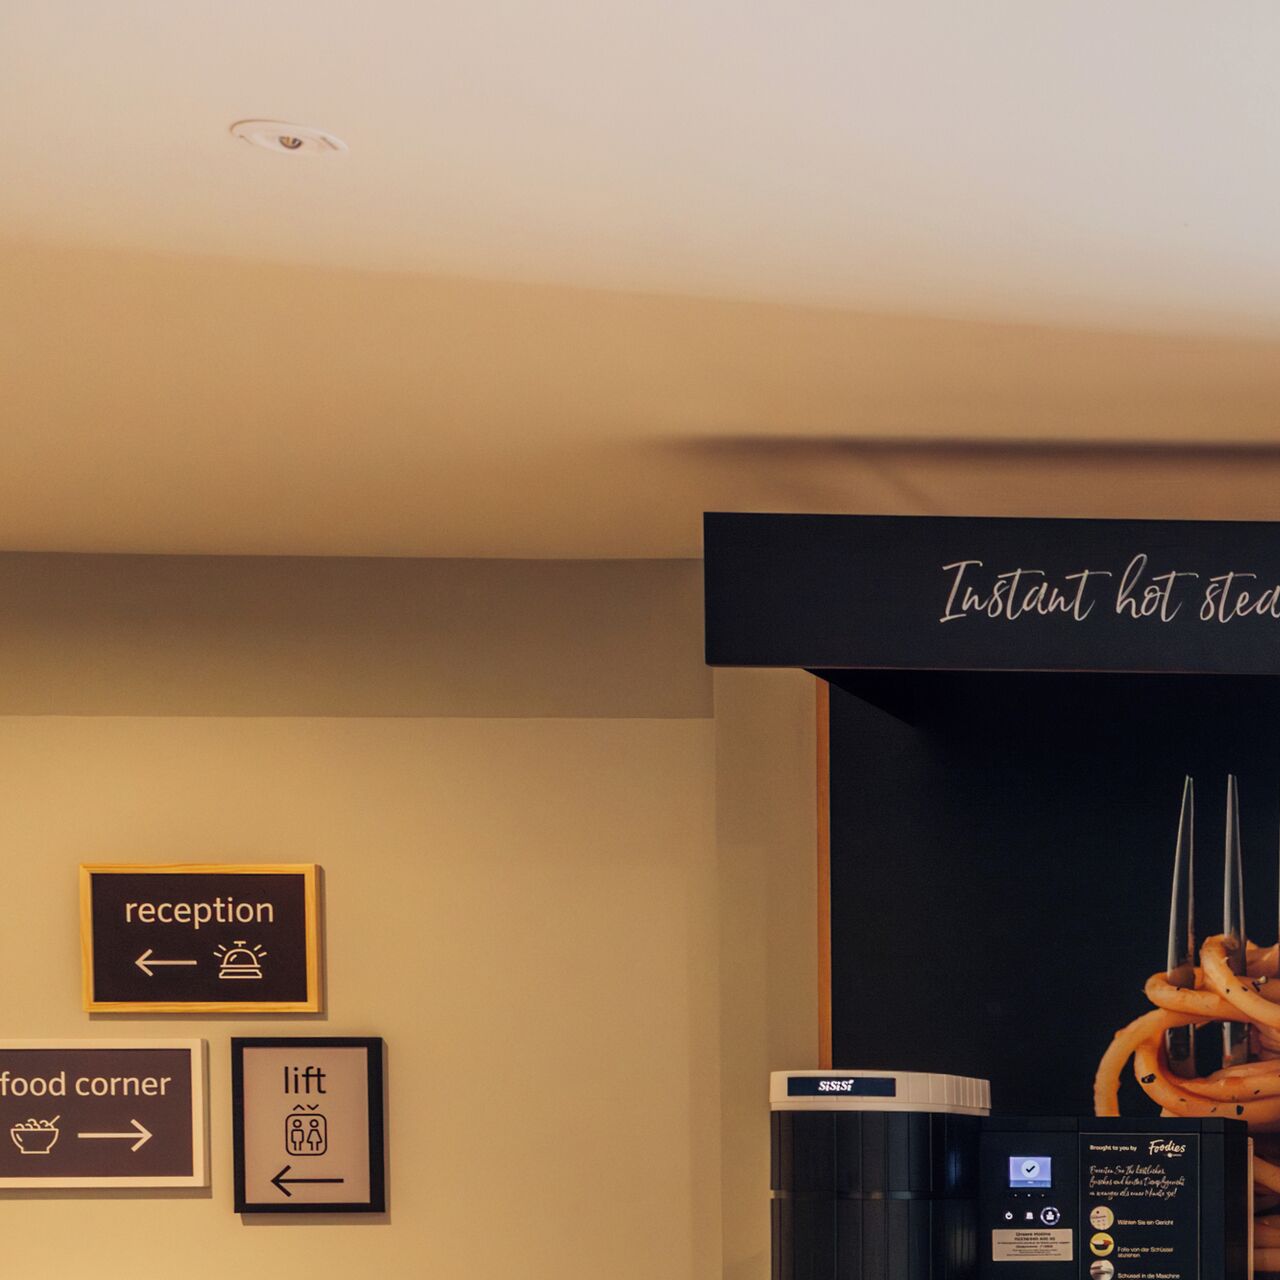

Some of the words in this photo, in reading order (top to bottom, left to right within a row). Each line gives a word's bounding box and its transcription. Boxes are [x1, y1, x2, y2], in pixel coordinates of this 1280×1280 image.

[939, 560, 1112, 623] Instant
[1115, 553, 1199, 623] hot
[125, 896, 274, 930] reception
[0, 1071, 66, 1097] food
[75, 1075, 171, 1097] corner
[283, 1066, 327, 1095] lift
[1148, 1139, 1186, 1156] Foodies
